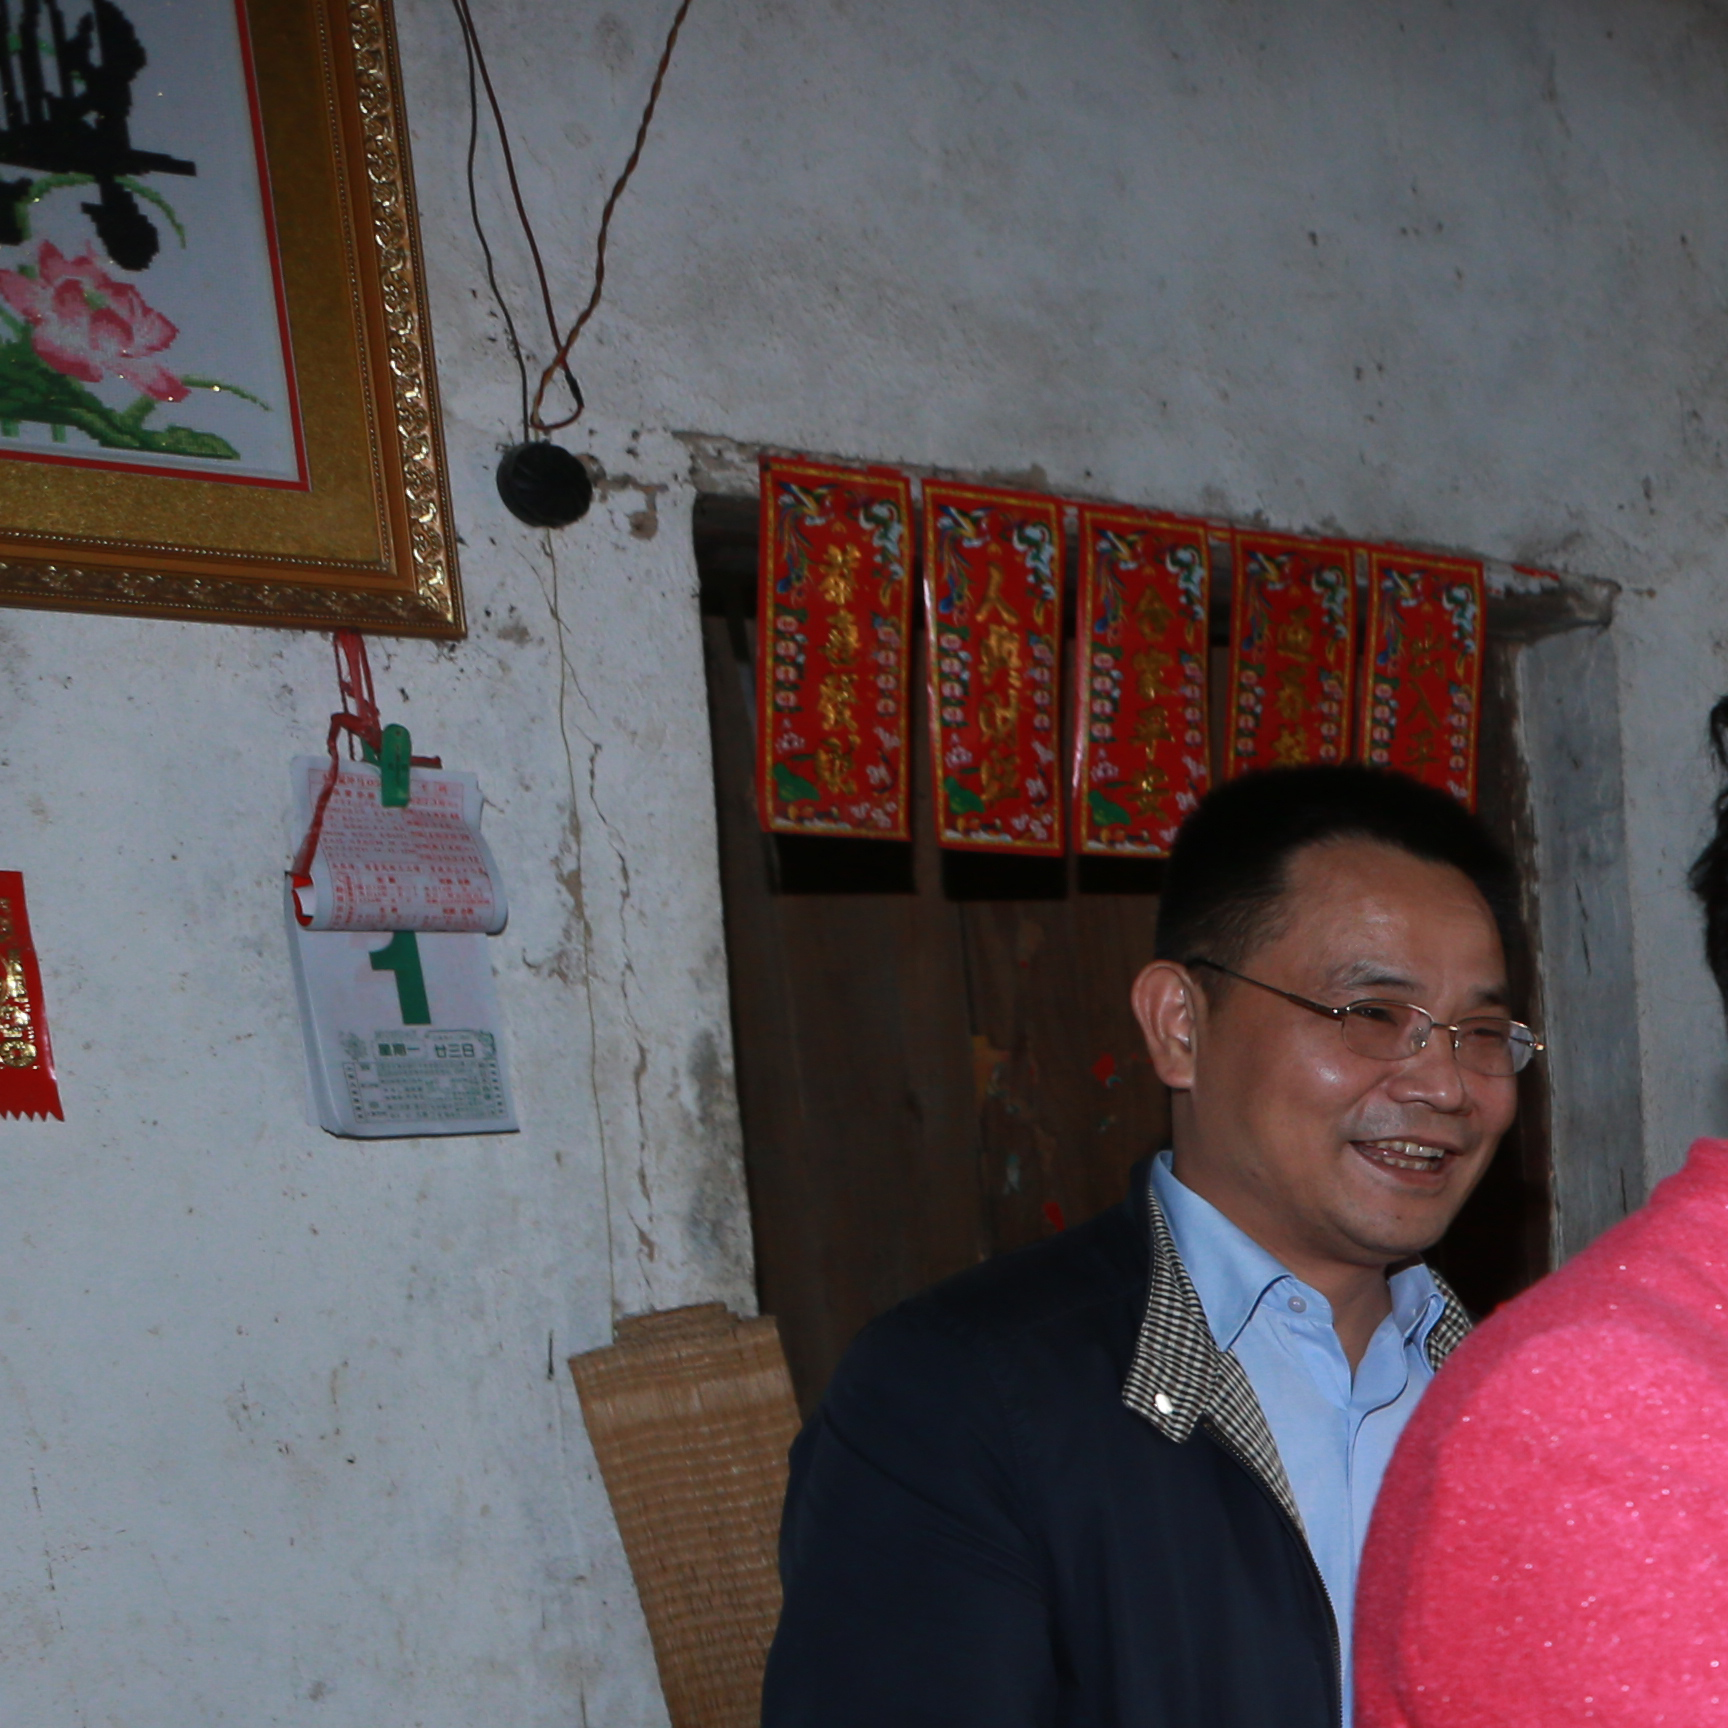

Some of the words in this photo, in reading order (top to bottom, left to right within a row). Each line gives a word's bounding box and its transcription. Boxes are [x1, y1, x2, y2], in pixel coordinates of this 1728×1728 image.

[1403, 620, 1448, 783] 出入平
[369, 931, 432, 1025] 1
